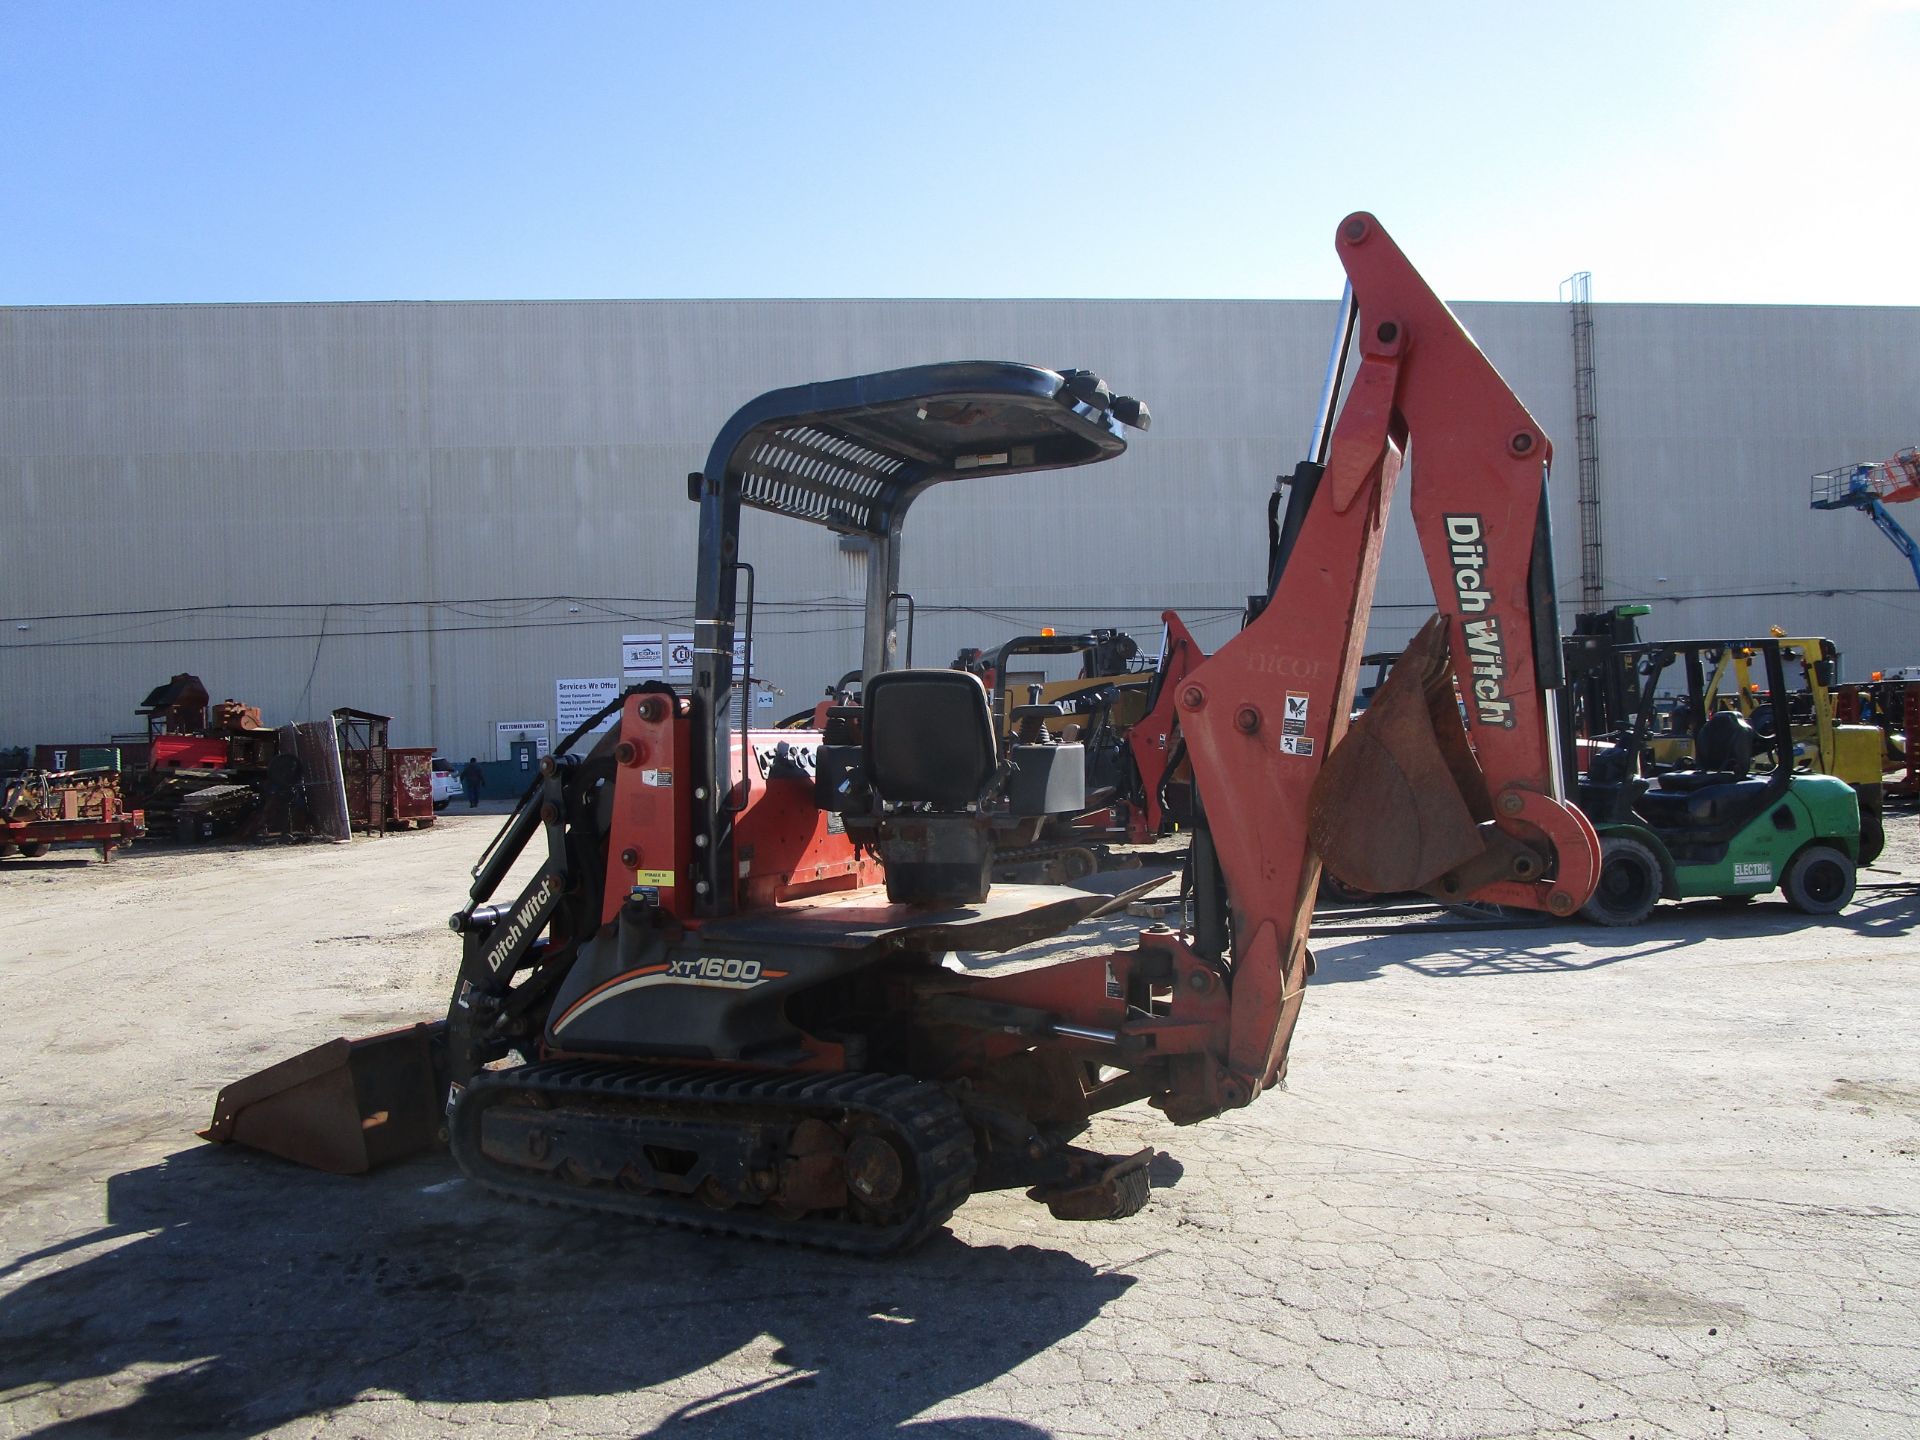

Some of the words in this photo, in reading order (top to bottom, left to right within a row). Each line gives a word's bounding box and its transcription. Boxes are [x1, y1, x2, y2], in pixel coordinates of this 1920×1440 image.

[1447, 517, 1491, 612] Ditch
[1734, 863, 1771, 876] ELECTRIC
[488, 925, 522, 973] Ditch
